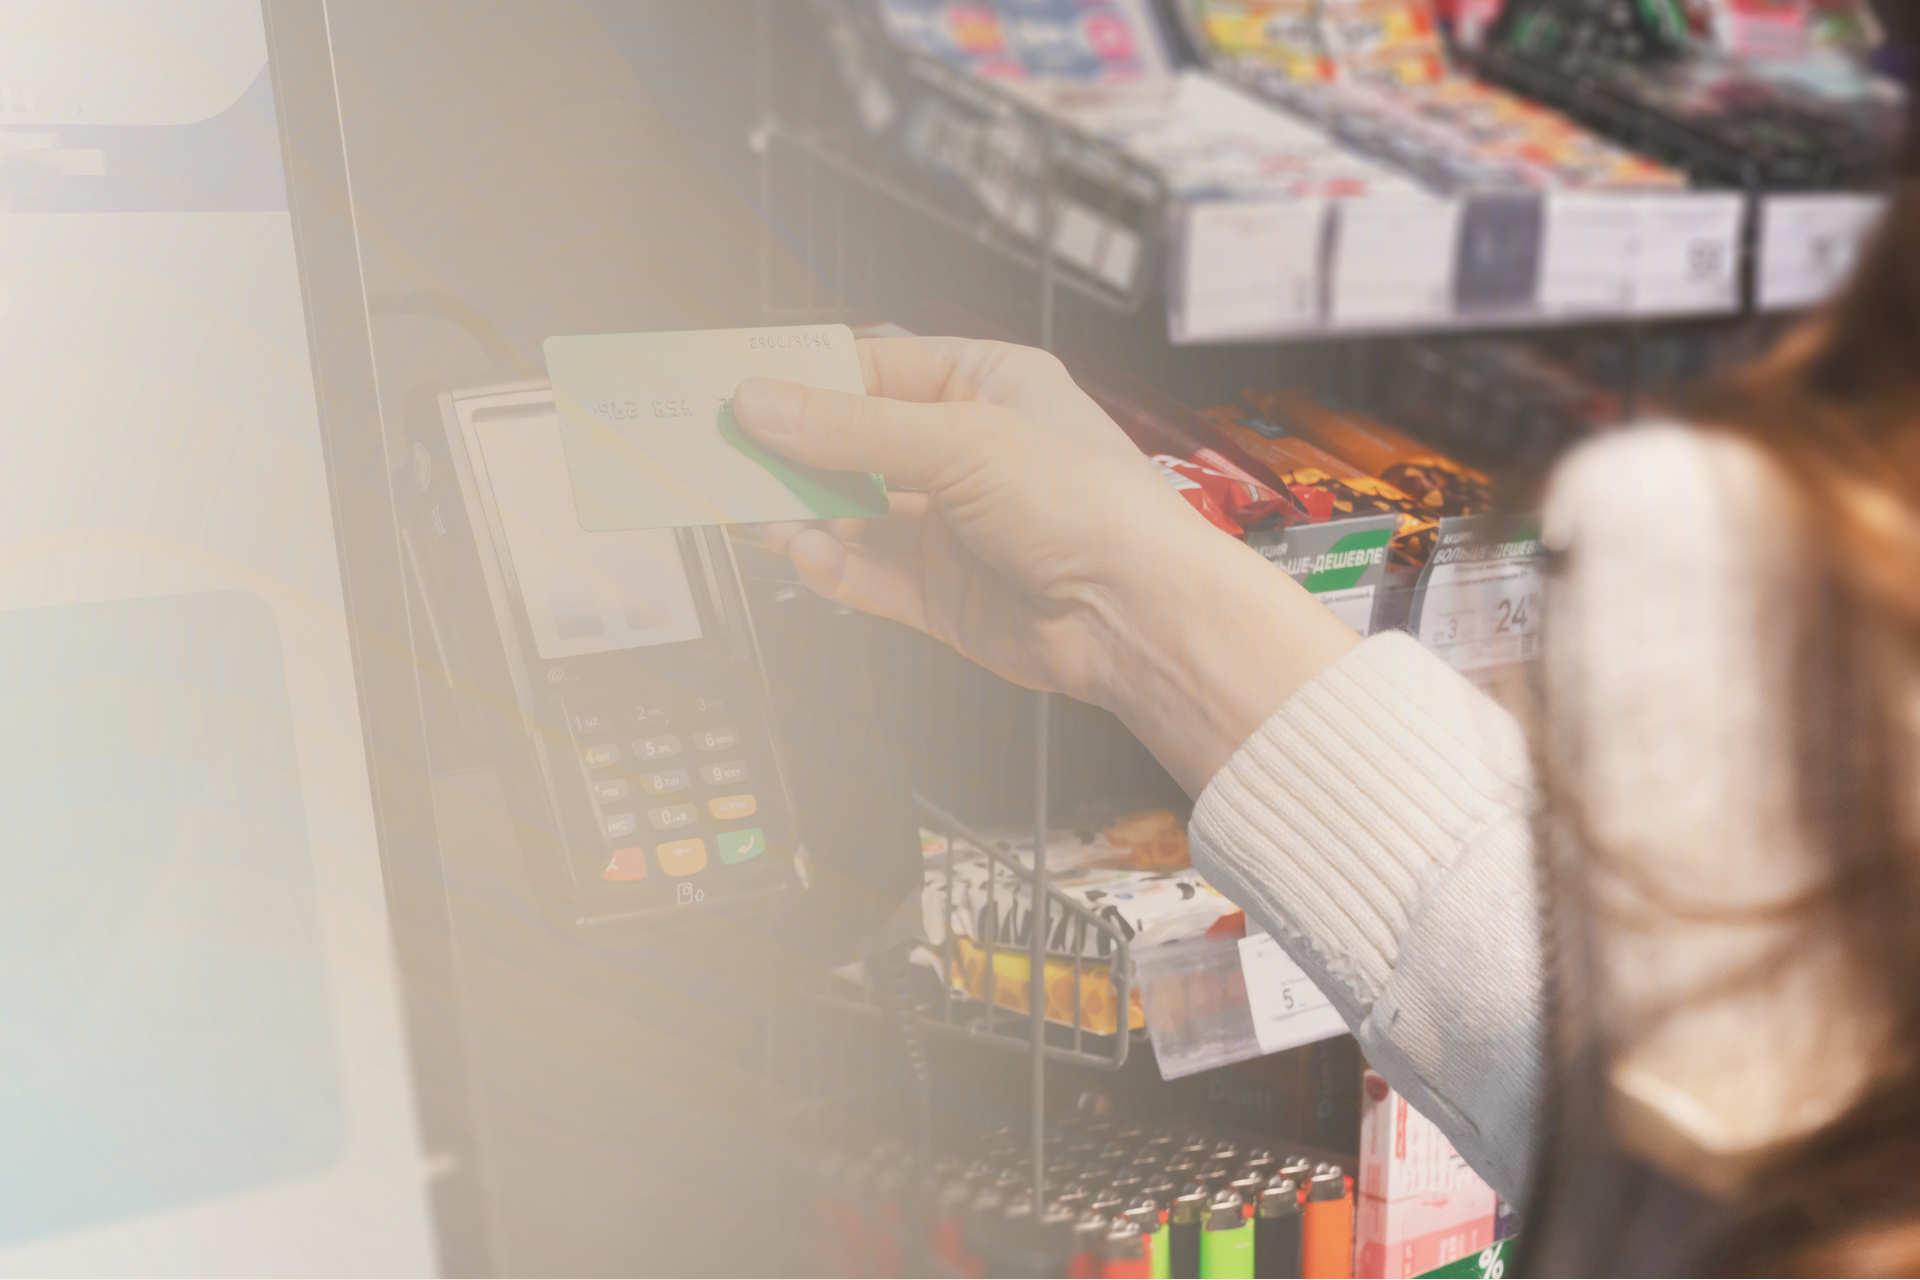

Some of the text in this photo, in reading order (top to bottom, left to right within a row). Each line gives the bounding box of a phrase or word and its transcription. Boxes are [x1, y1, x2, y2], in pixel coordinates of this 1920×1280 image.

[696, 697, 724, 712] 3 DEF
[636, 706, 665, 720] 2 ABC
[574, 716, 583, 730] 1
[704, 732, 734, 747] 6 MNO
[645, 741, 673, 756] 5 JKL
[585, 750, 611, 764] 4 GHI
[712, 767, 742, 781] 9 WXY
[652, 775, 681, 790] 8 TUV
[601, 787, 619, 798] PRS
[718, 801, 748, 812] ALPHA
[661, 810, 672, 825] 0
[1282, 988, 1294, 1010] 5
